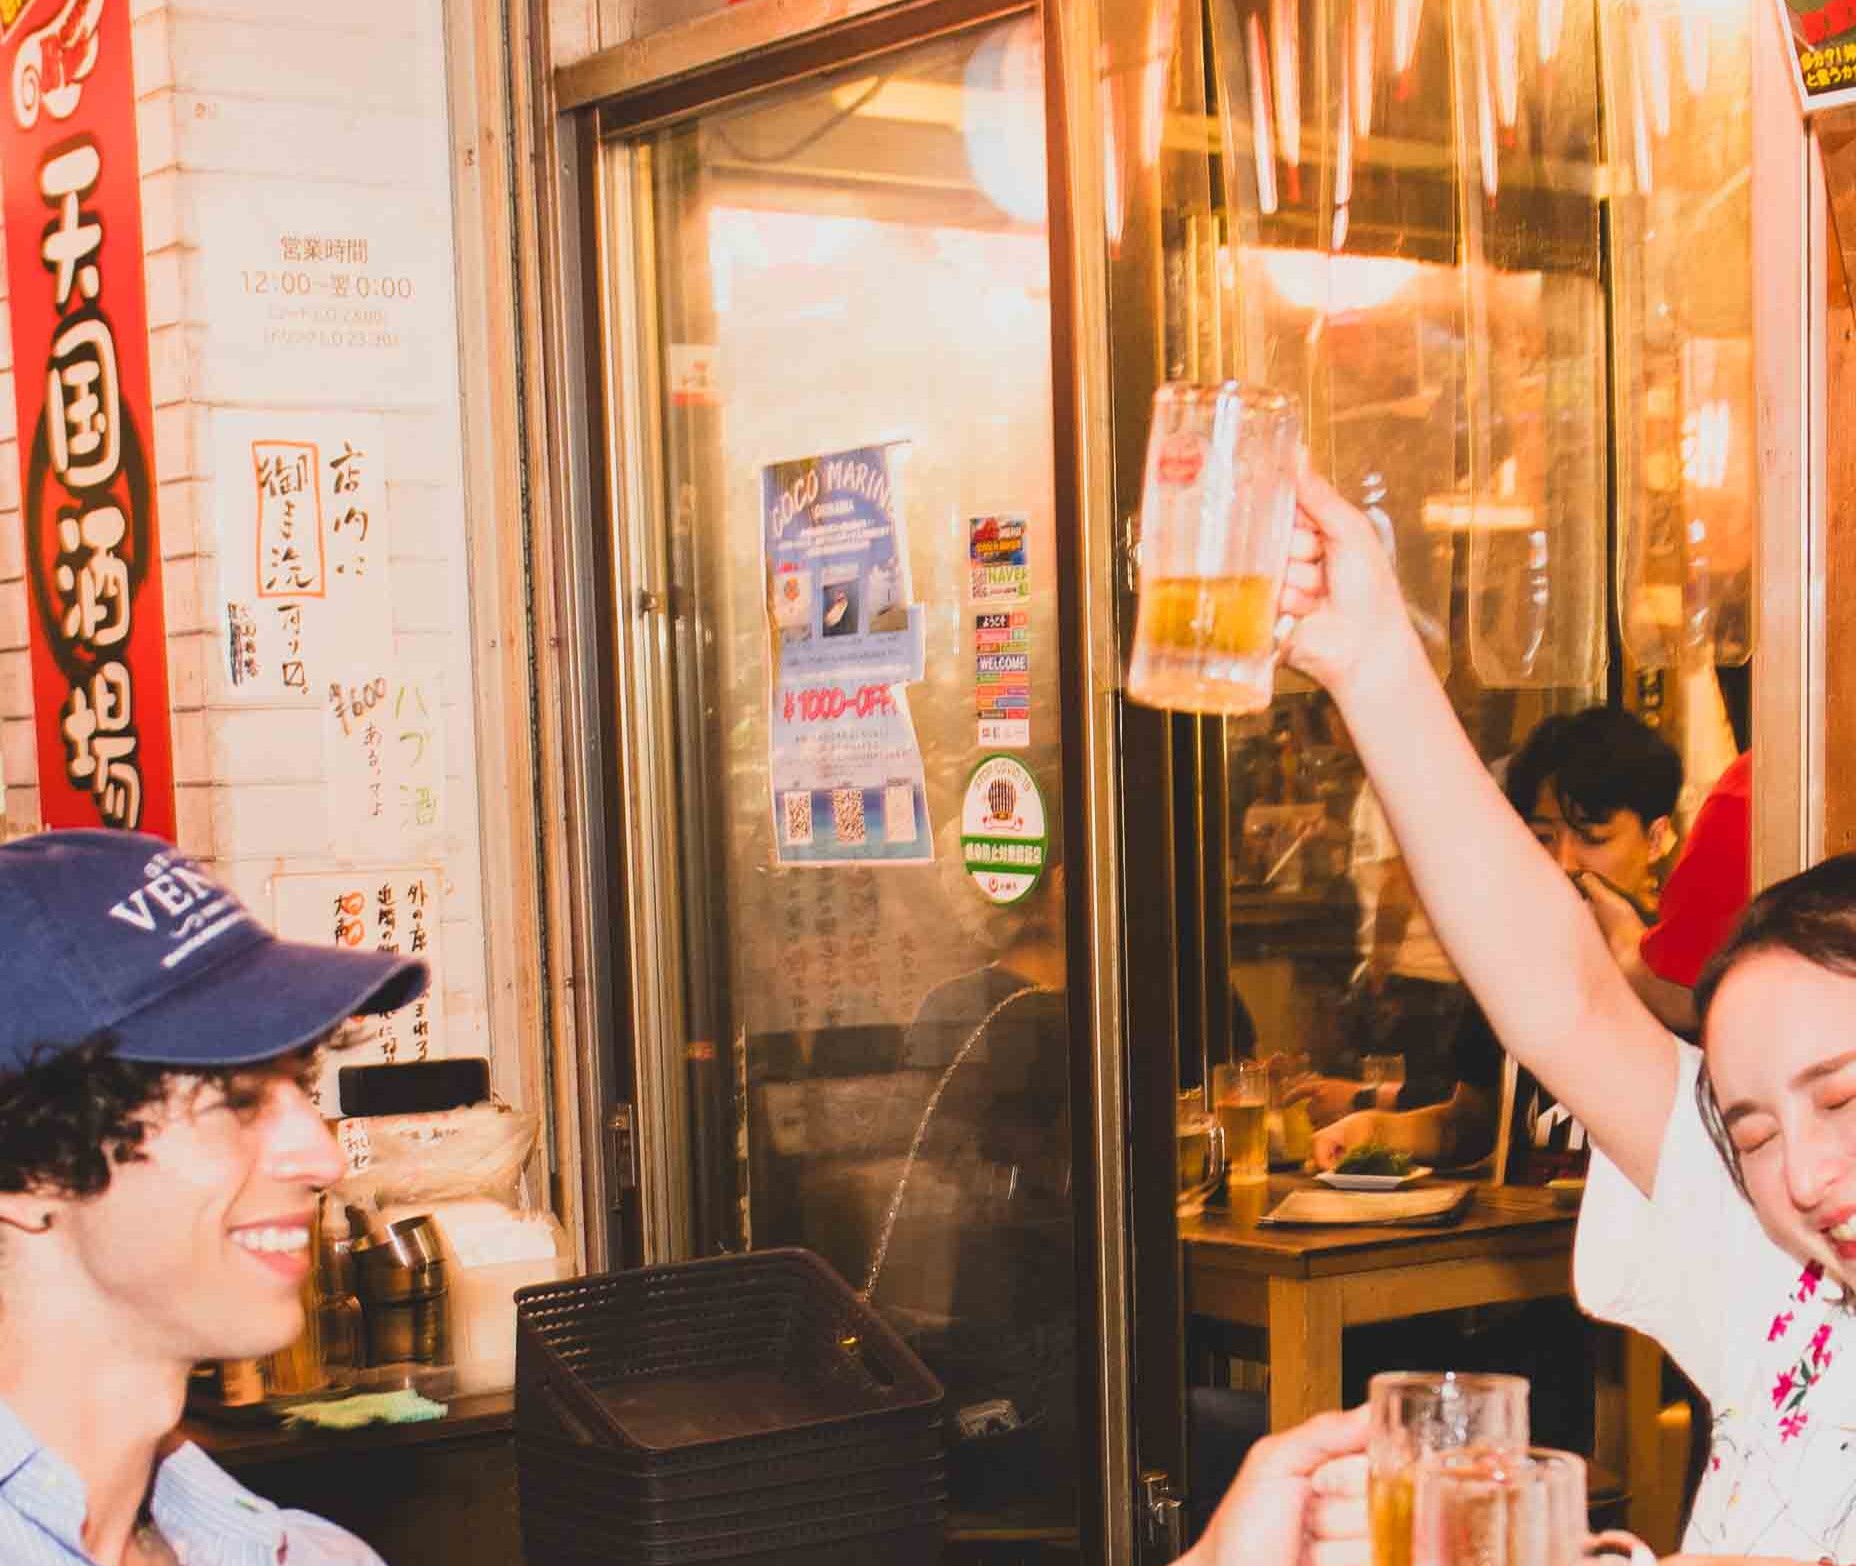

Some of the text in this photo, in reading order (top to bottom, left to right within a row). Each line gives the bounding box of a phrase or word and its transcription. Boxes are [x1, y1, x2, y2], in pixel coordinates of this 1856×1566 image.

[280, 234, 369, 264] 営業時間
[39, 143, 142, 831] 天国酒場
[980, 656, 1027, 671] WELCOME
